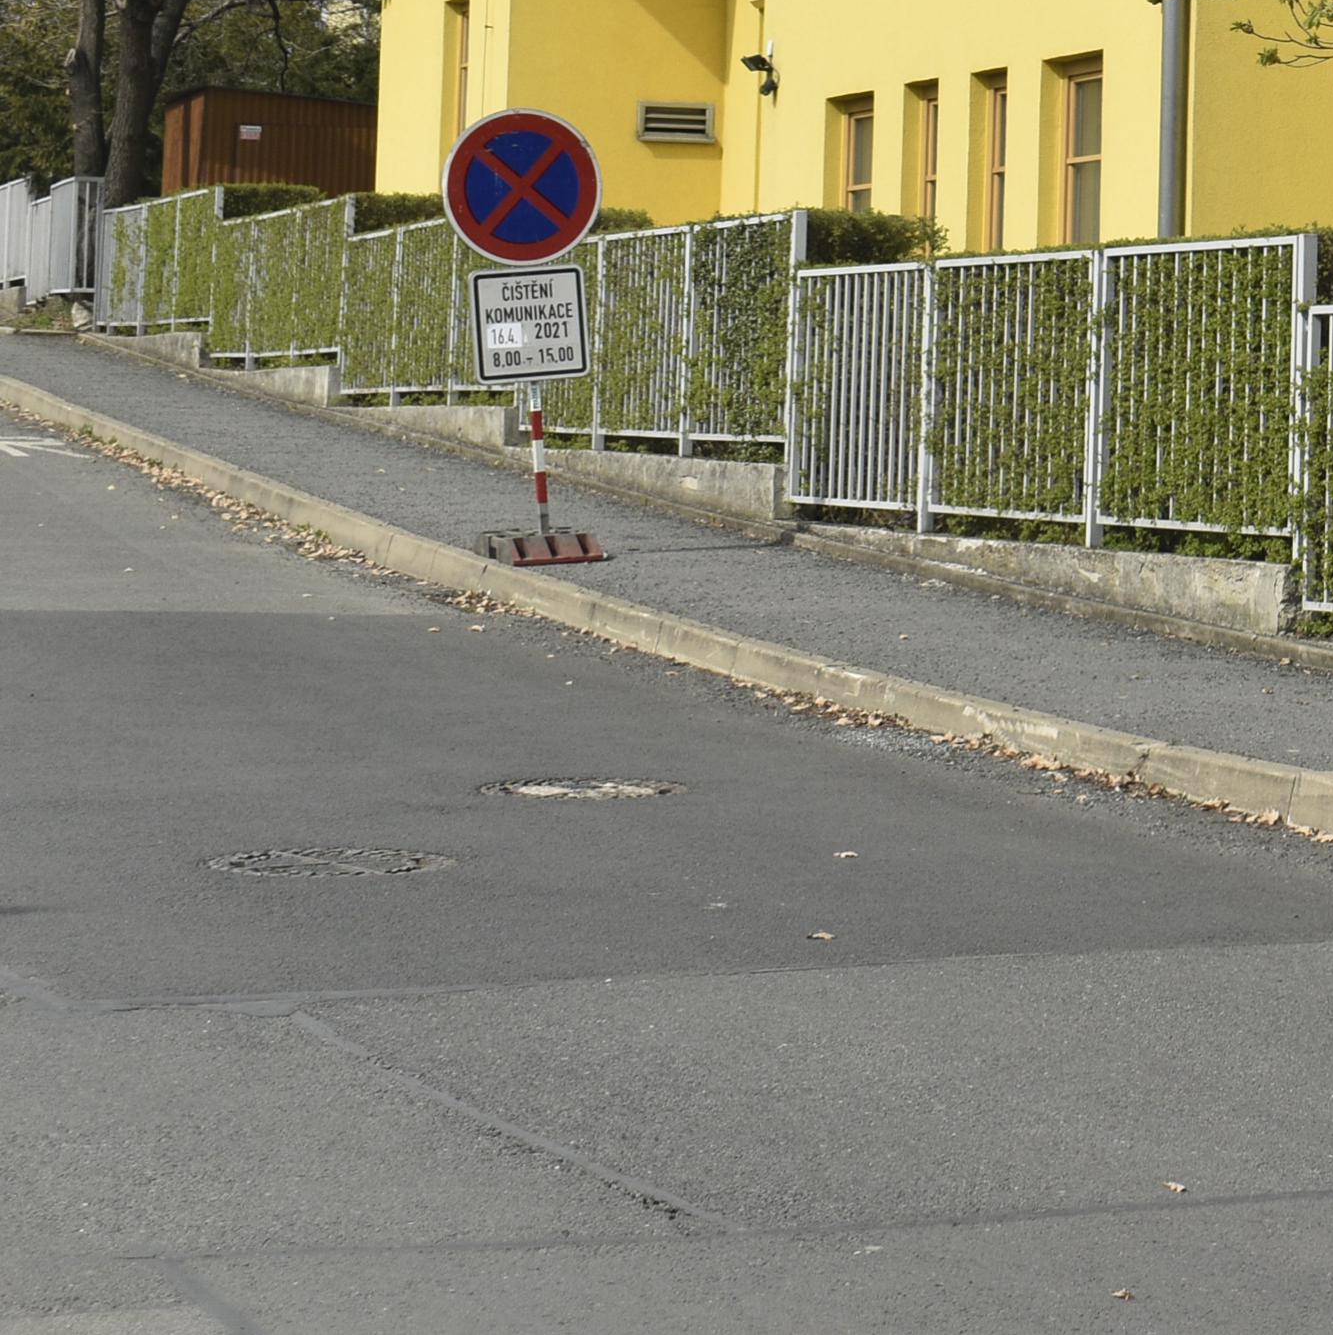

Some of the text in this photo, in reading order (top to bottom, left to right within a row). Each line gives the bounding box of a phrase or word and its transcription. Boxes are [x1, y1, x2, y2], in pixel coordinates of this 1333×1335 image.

[502, 278, 554, 302] ČIŠTĚNÍ
[485, 302, 574, 325] KOMUNIKACE
[491, 320, 569, 345] 16.4. 2021
